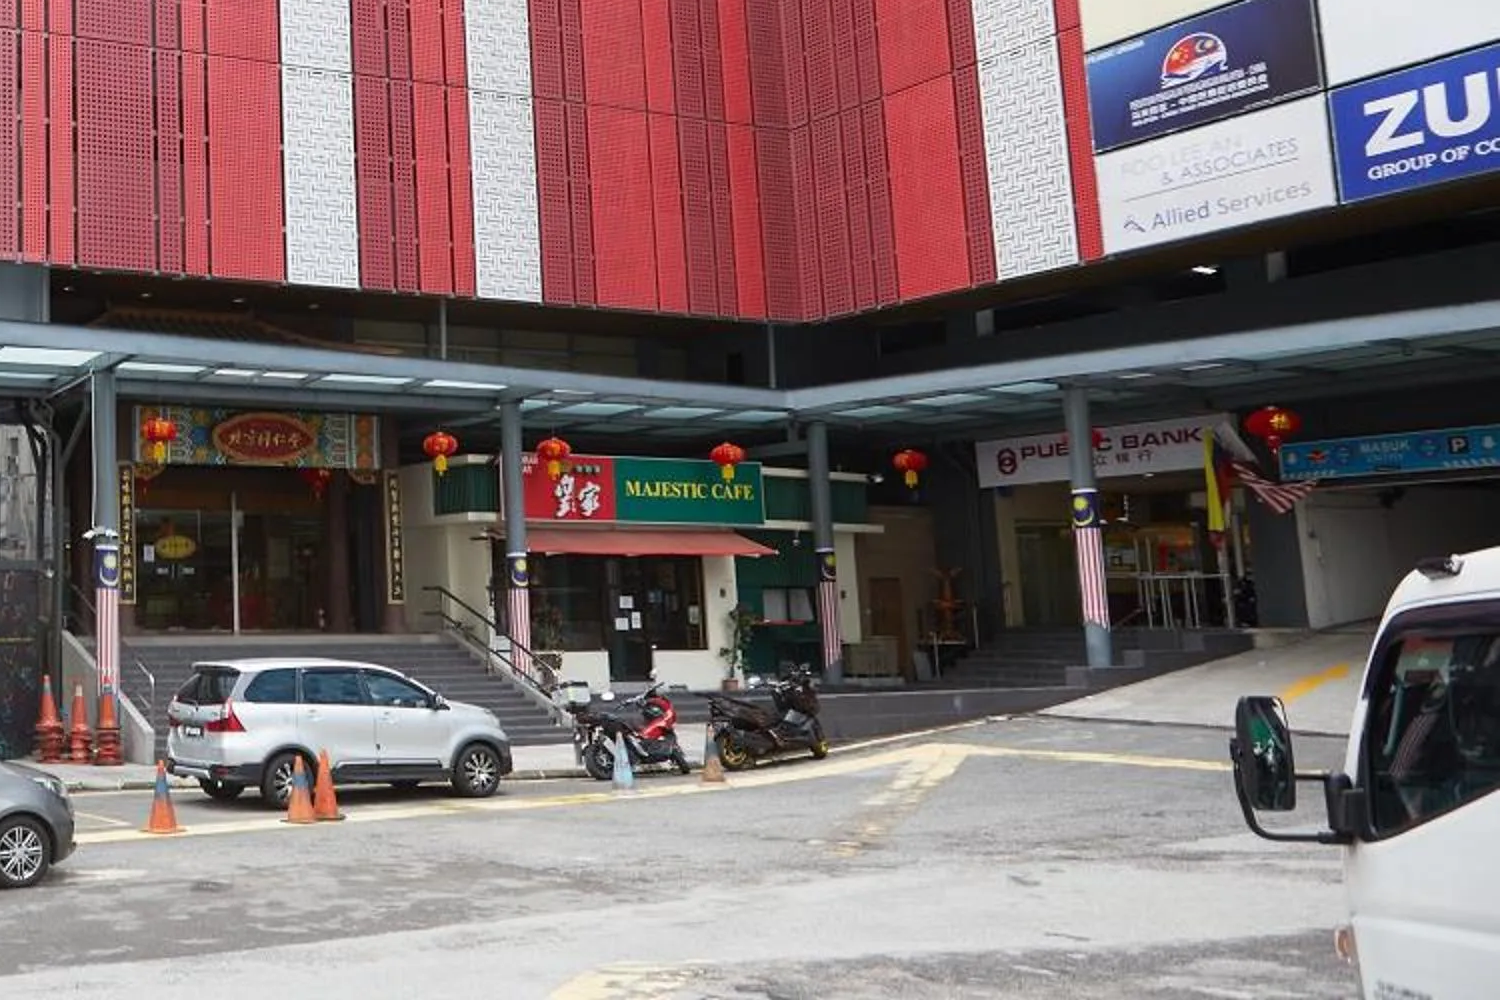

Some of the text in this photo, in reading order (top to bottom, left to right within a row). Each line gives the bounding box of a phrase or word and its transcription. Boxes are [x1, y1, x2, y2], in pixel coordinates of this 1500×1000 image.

[1363, 67, 1500, 157] ZU
[1181, 138, 1299, 178] ASSOCIATES
[1368, 153, 1437, 180] GROUP
[1441, 145, 1470, 163] OF
[1152, 182, 1311, 230] Allied Services
[1121, 427, 1204, 449] BANK
[626, 480, 754, 501] MAJESTIC CAFE
